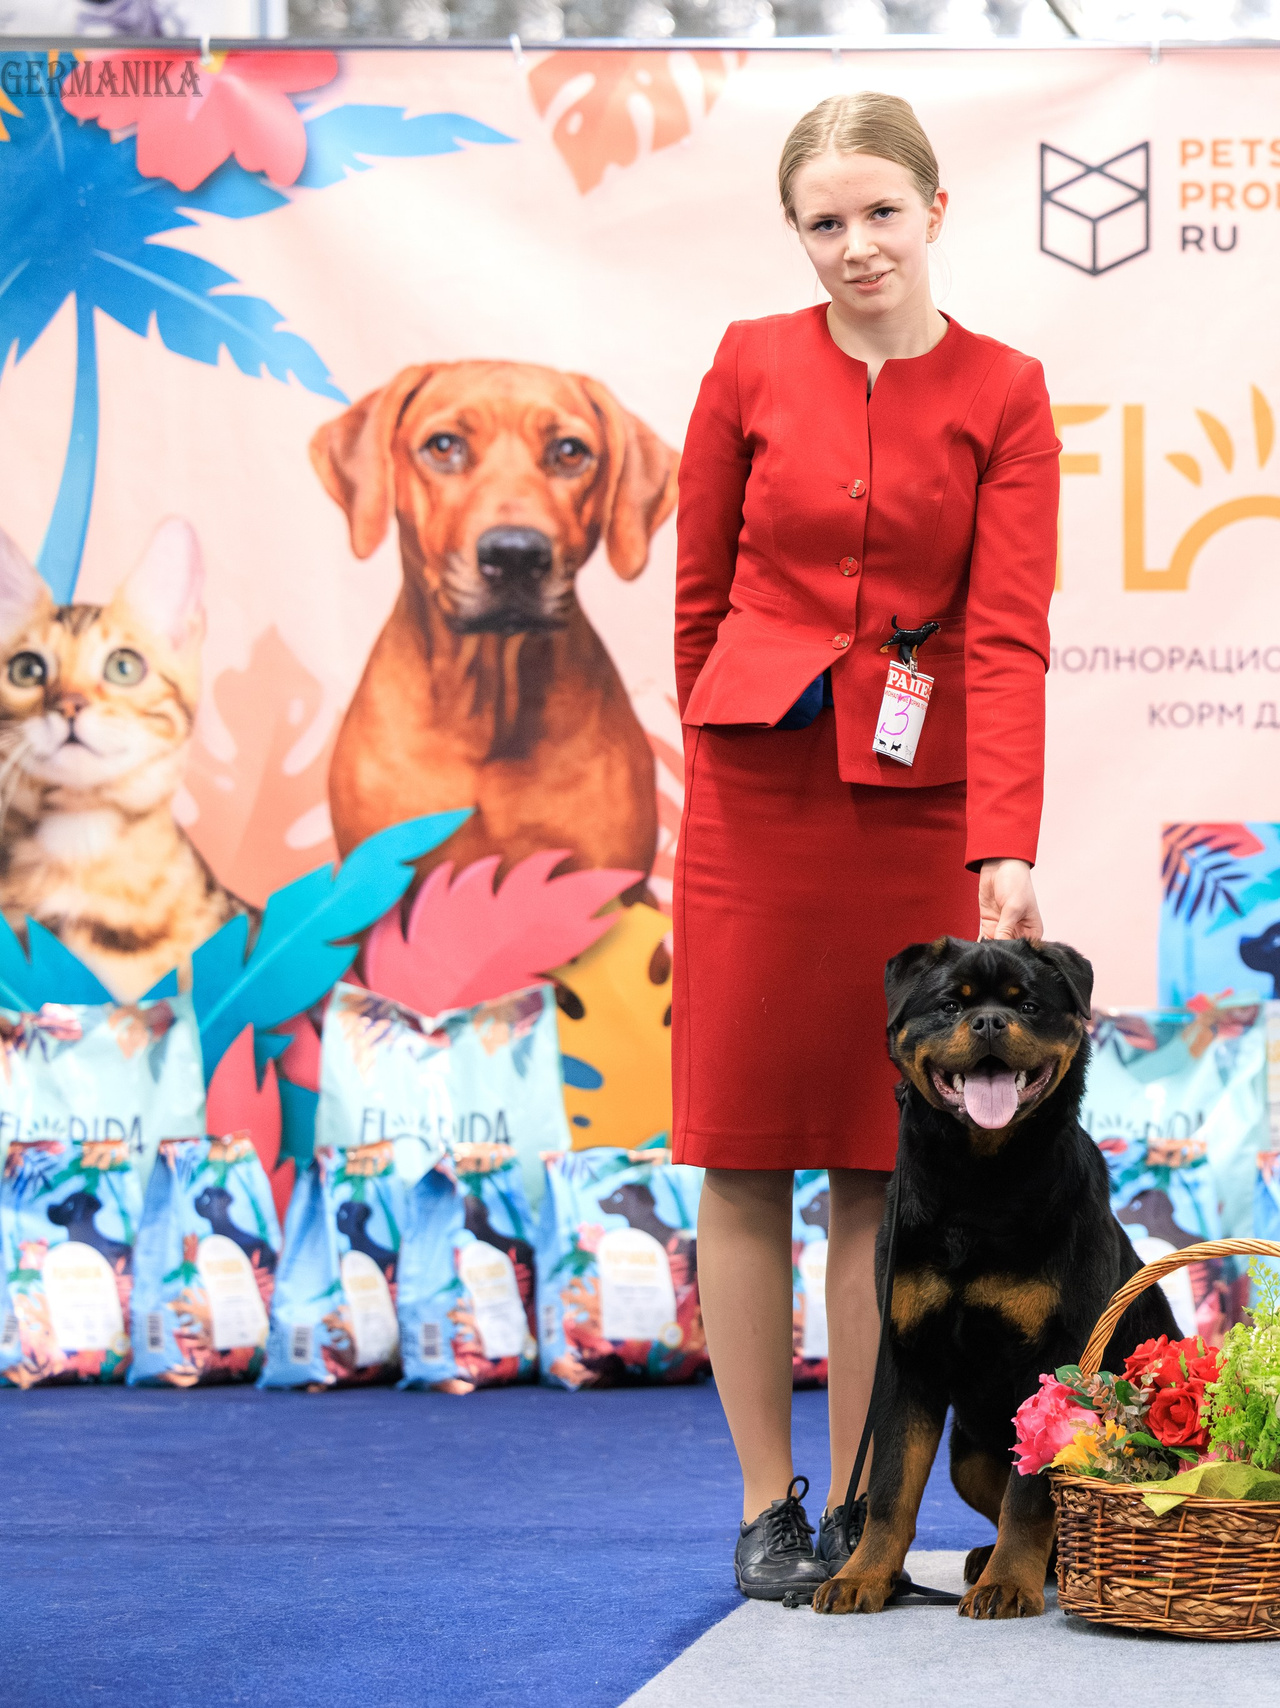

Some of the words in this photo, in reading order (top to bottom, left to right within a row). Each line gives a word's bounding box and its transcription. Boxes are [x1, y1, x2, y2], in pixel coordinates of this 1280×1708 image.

[1180, 224, 1238, 252] RU
[887, 669, 931, 699] РАПЕ
[879, 693, 912, 736] 3
[1148, 701, 1244, 728] КОРМ
